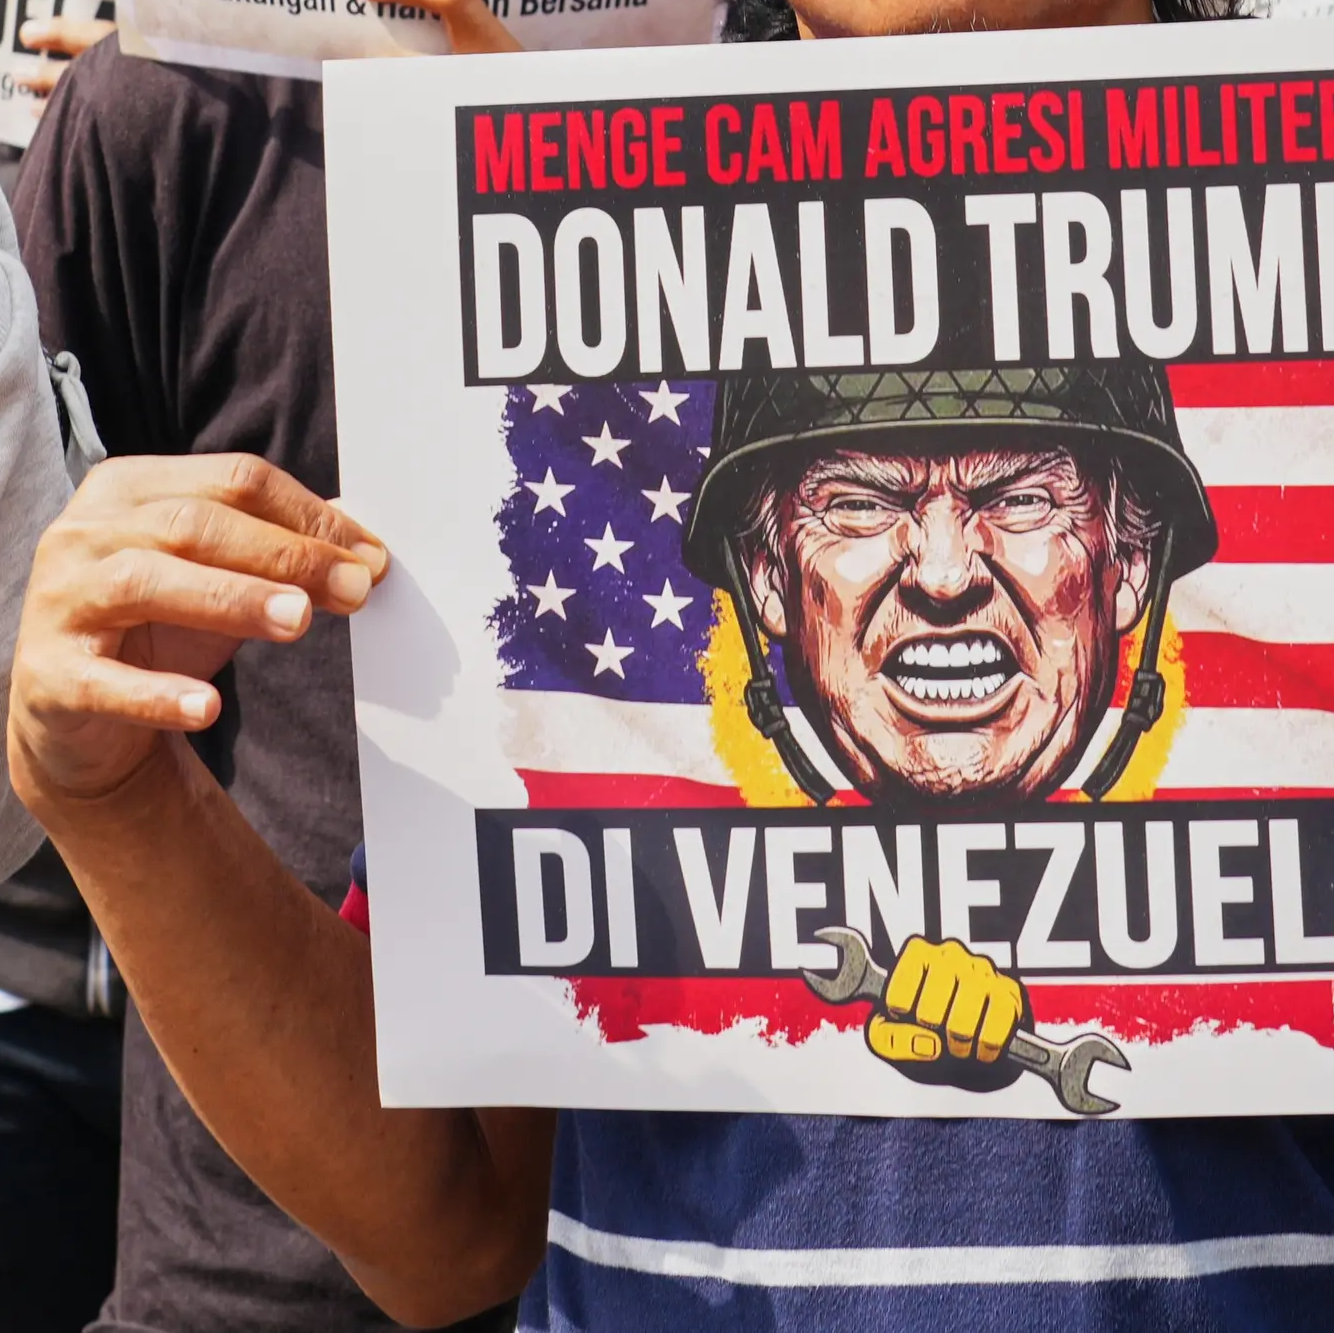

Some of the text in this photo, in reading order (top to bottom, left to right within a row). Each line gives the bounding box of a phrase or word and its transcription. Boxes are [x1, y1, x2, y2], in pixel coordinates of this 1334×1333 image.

[471, 105, 686, 194] MENGE
[704, 97, 845, 186] CAM
[866, 90, 1085, 180] AGRESI
[470, 195, 941, 380] DONALD
[511, 825, 640, 969] DI
